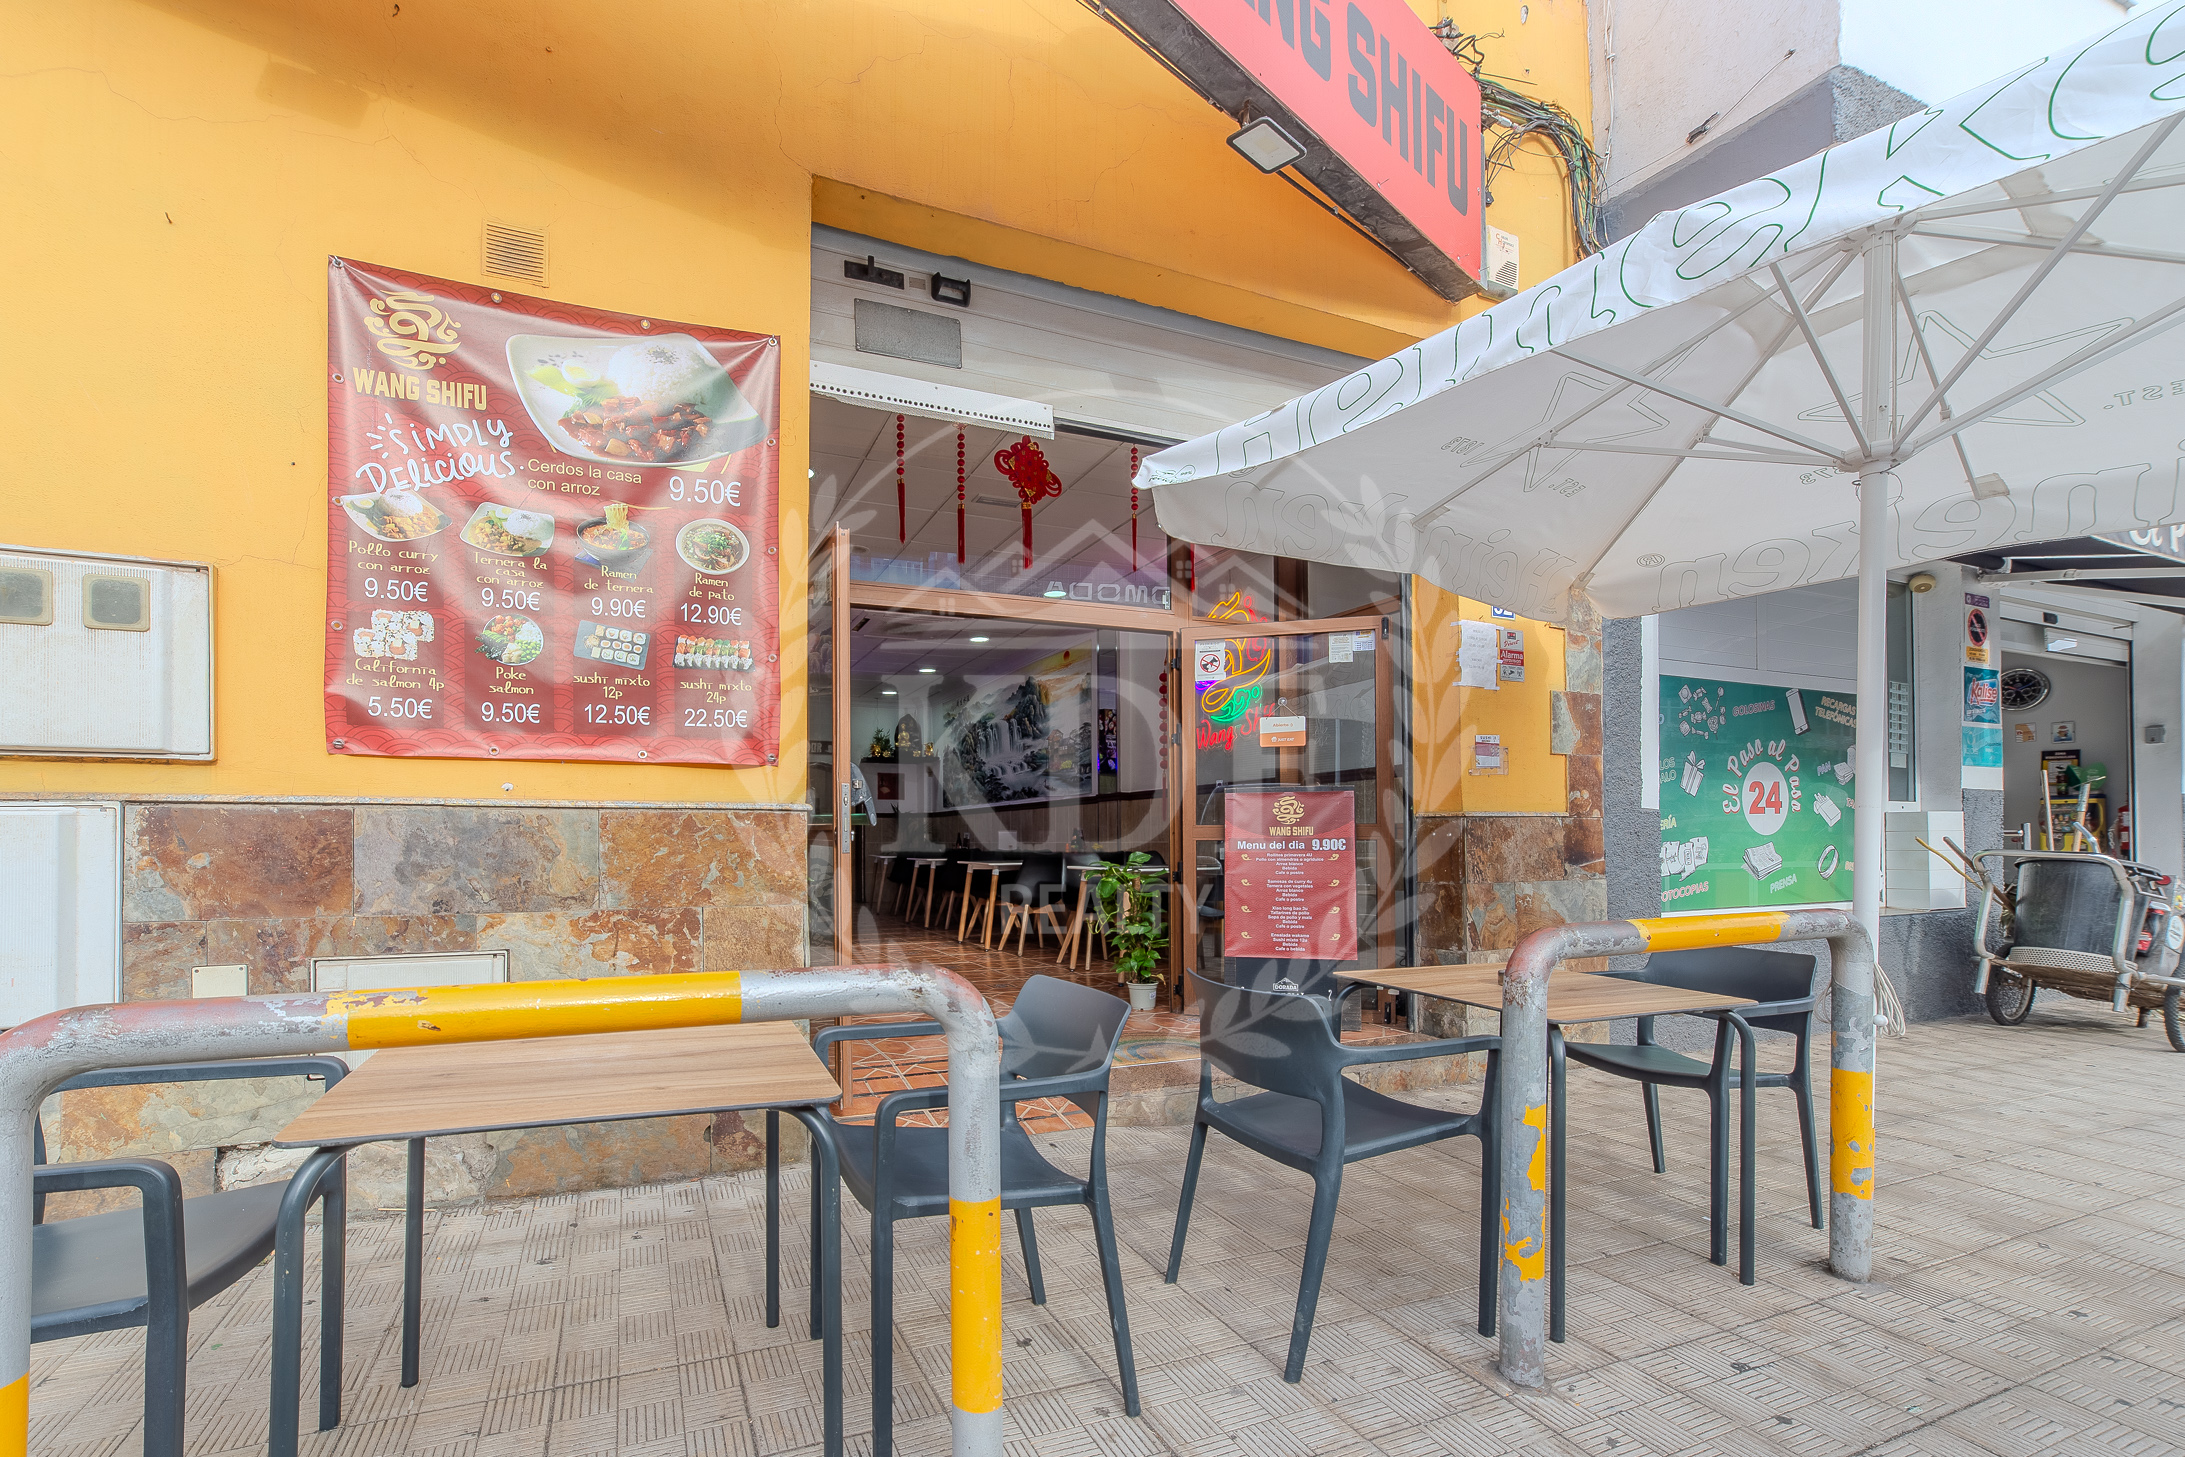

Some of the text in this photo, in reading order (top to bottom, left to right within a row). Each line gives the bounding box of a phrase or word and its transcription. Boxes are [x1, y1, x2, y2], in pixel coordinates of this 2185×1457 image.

[1346, 2, 1468, 217] SHIFU
[352, 366, 488, 412] WANG SHIFU
[527, 459, 643, 485] Cerdos la casa
[527, 479, 601, 497] con arroz
[668, 476, 742, 508] 9.50€
[348, 540, 440, 564] Pollo curry
[473, 551, 548, 571] Ternera la
[358, 561, 431, 576] con arroz
[495, 568, 526, 579] casa
[600, 565, 637, 580] Ramen
[476, 575, 545, 589] con arroz
[584, 579, 654, 595] de ternera
[694, 573, 729, 588] Ramen
[363, 577, 429, 603] 9.50€
[689, 587, 735, 602] de pato
[480, 587, 541, 612] 9.50€
[590, 597, 647, 619] 9.90€
[679, 602, 743, 626] 12.90€
[1501, 651, 1524, 660] Alarma
[354, 658, 437, 676] California
[496, 667, 527, 682] Poke
[346, 674, 445, 692] de salmon 4p
[488, 680, 535, 696] salmon
[573, 673, 651, 688] sushi mixto
[680, 679, 752, 693] sushi mixto
[602, 686, 623, 700] 12p
[706, 691, 728, 705] 24p
[1970, 677, 1998, 705] Kalise
[367, 695, 433, 720] 5.50€
[480, 701, 541, 725] 9.50€
[1732, 699, 1776, 717] GOLOSINAS
[1820, 695, 1857, 716] RECARGAS
[583, 703, 651, 727] 12.50€
[683, 708, 748, 729] 22.50€
[1196, 719, 1235, 750] Wang
[1660, 756, 1676, 771] LOS
[1817, 760, 1832, 776] PAN
[1660, 770, 1677, 784] ALO
[1722, 738, 1803, 815] El Paso al Paso
[1748, 781, 1783, 815] 24
[1269, 826, 1314, 836] WANG SHIFU
[1660, 814, 1677, 831] ERÍA
[1237, 838, 1347, 851] Menu del dia 9.90€
[1661, 881, 1710, 903] OTOCOPIAS
[1770, 873, 1798, 894] PRENSA
